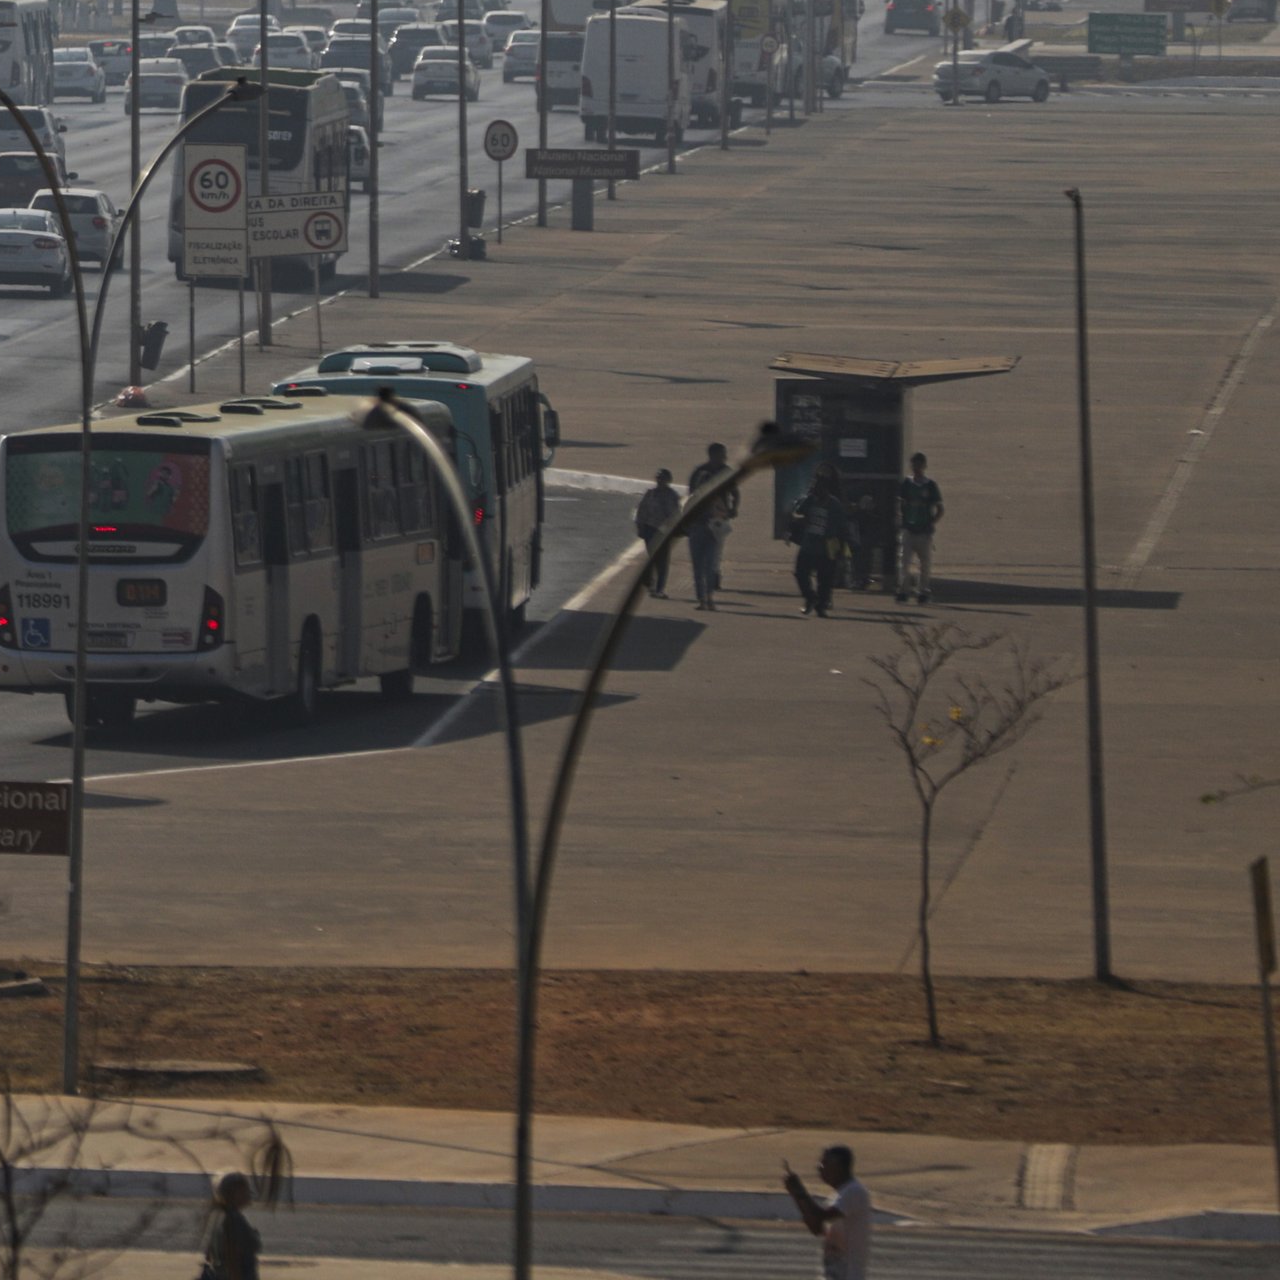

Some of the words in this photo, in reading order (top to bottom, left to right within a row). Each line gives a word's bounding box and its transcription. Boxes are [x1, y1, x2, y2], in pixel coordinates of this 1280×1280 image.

[491, 134, 510, 147] 60
[577, 152, 627, 162] Nacional
[200, 171, 229, 189] 60
[200, 191, 230, 200] km/h
[268, 197, 286, 209] DA
[291, 195, 338, 208] DIREITA
[253, 228, 299, 241] ESCOLAR
[16, 593, 70, 609] 118991
